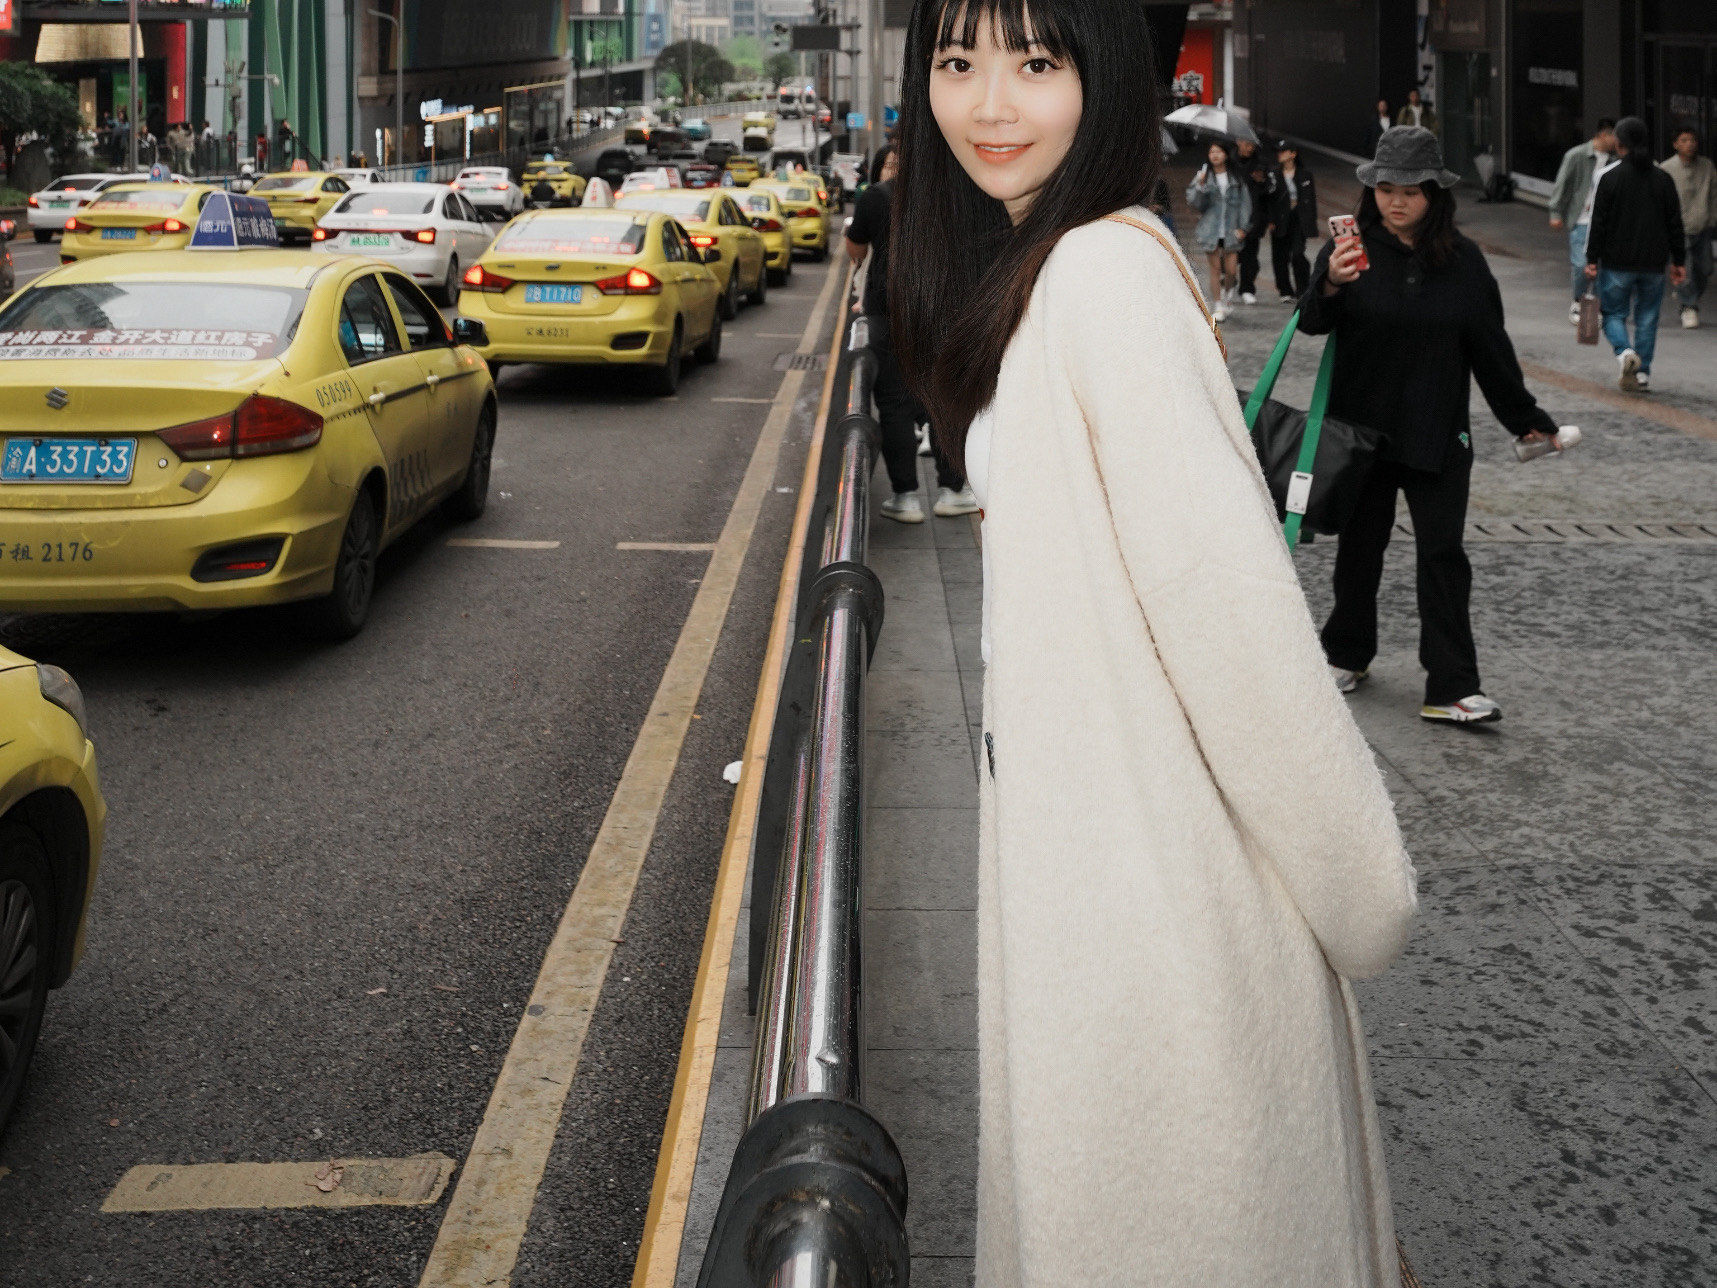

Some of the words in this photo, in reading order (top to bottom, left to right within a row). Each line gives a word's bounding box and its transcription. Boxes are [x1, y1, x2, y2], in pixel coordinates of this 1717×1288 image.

[89, 329, 274, 347] 金开大道红房子
[316, 379, 352, 407] 050599
[41, 541, 94, 562] 2176
